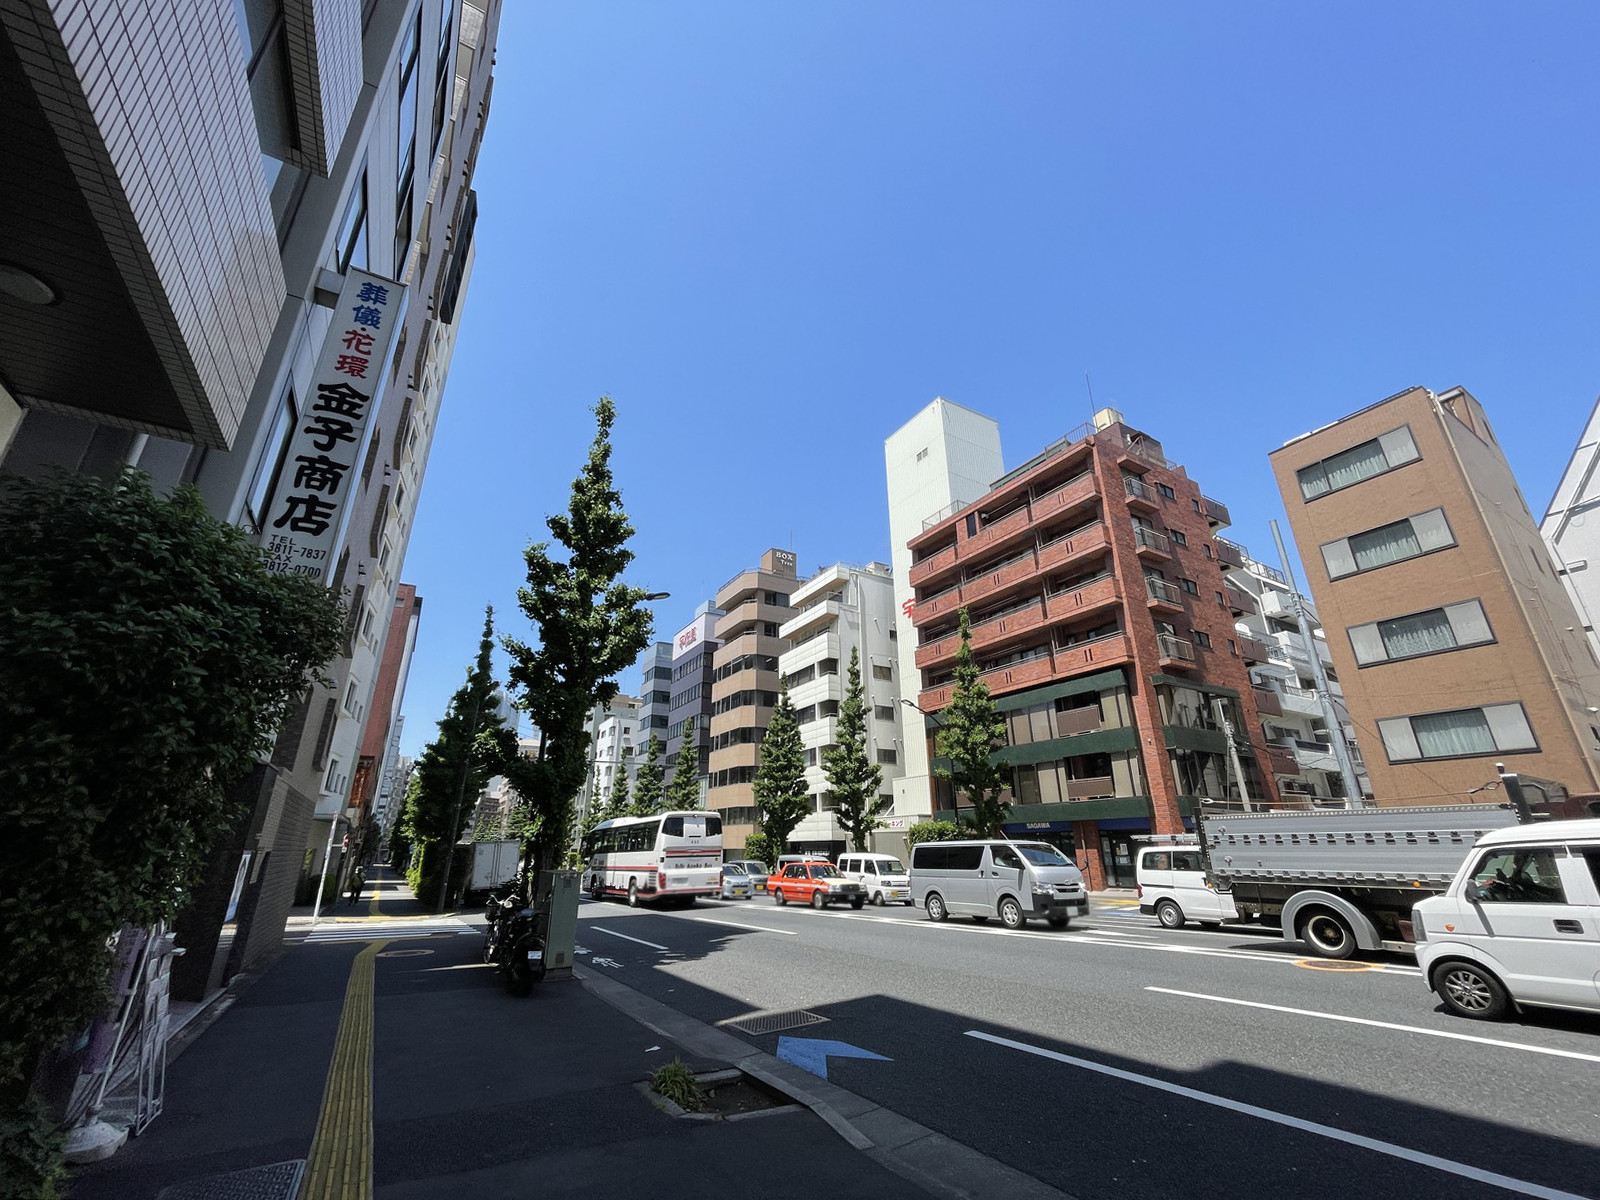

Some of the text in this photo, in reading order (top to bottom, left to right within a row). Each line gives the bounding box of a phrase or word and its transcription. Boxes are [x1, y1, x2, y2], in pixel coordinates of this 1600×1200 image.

[273, 381, 371, 537] 金子商店
[271, 533, 297, 546] TEL
[267, 541, 327, 561] 3811-7837
[268, 552, 293, 563] AX
[776, 551, 793, 561] BOX
[262, 559, 322, 578] 3812-0700
[1026, 822, 1051, 830] SAGAWA
